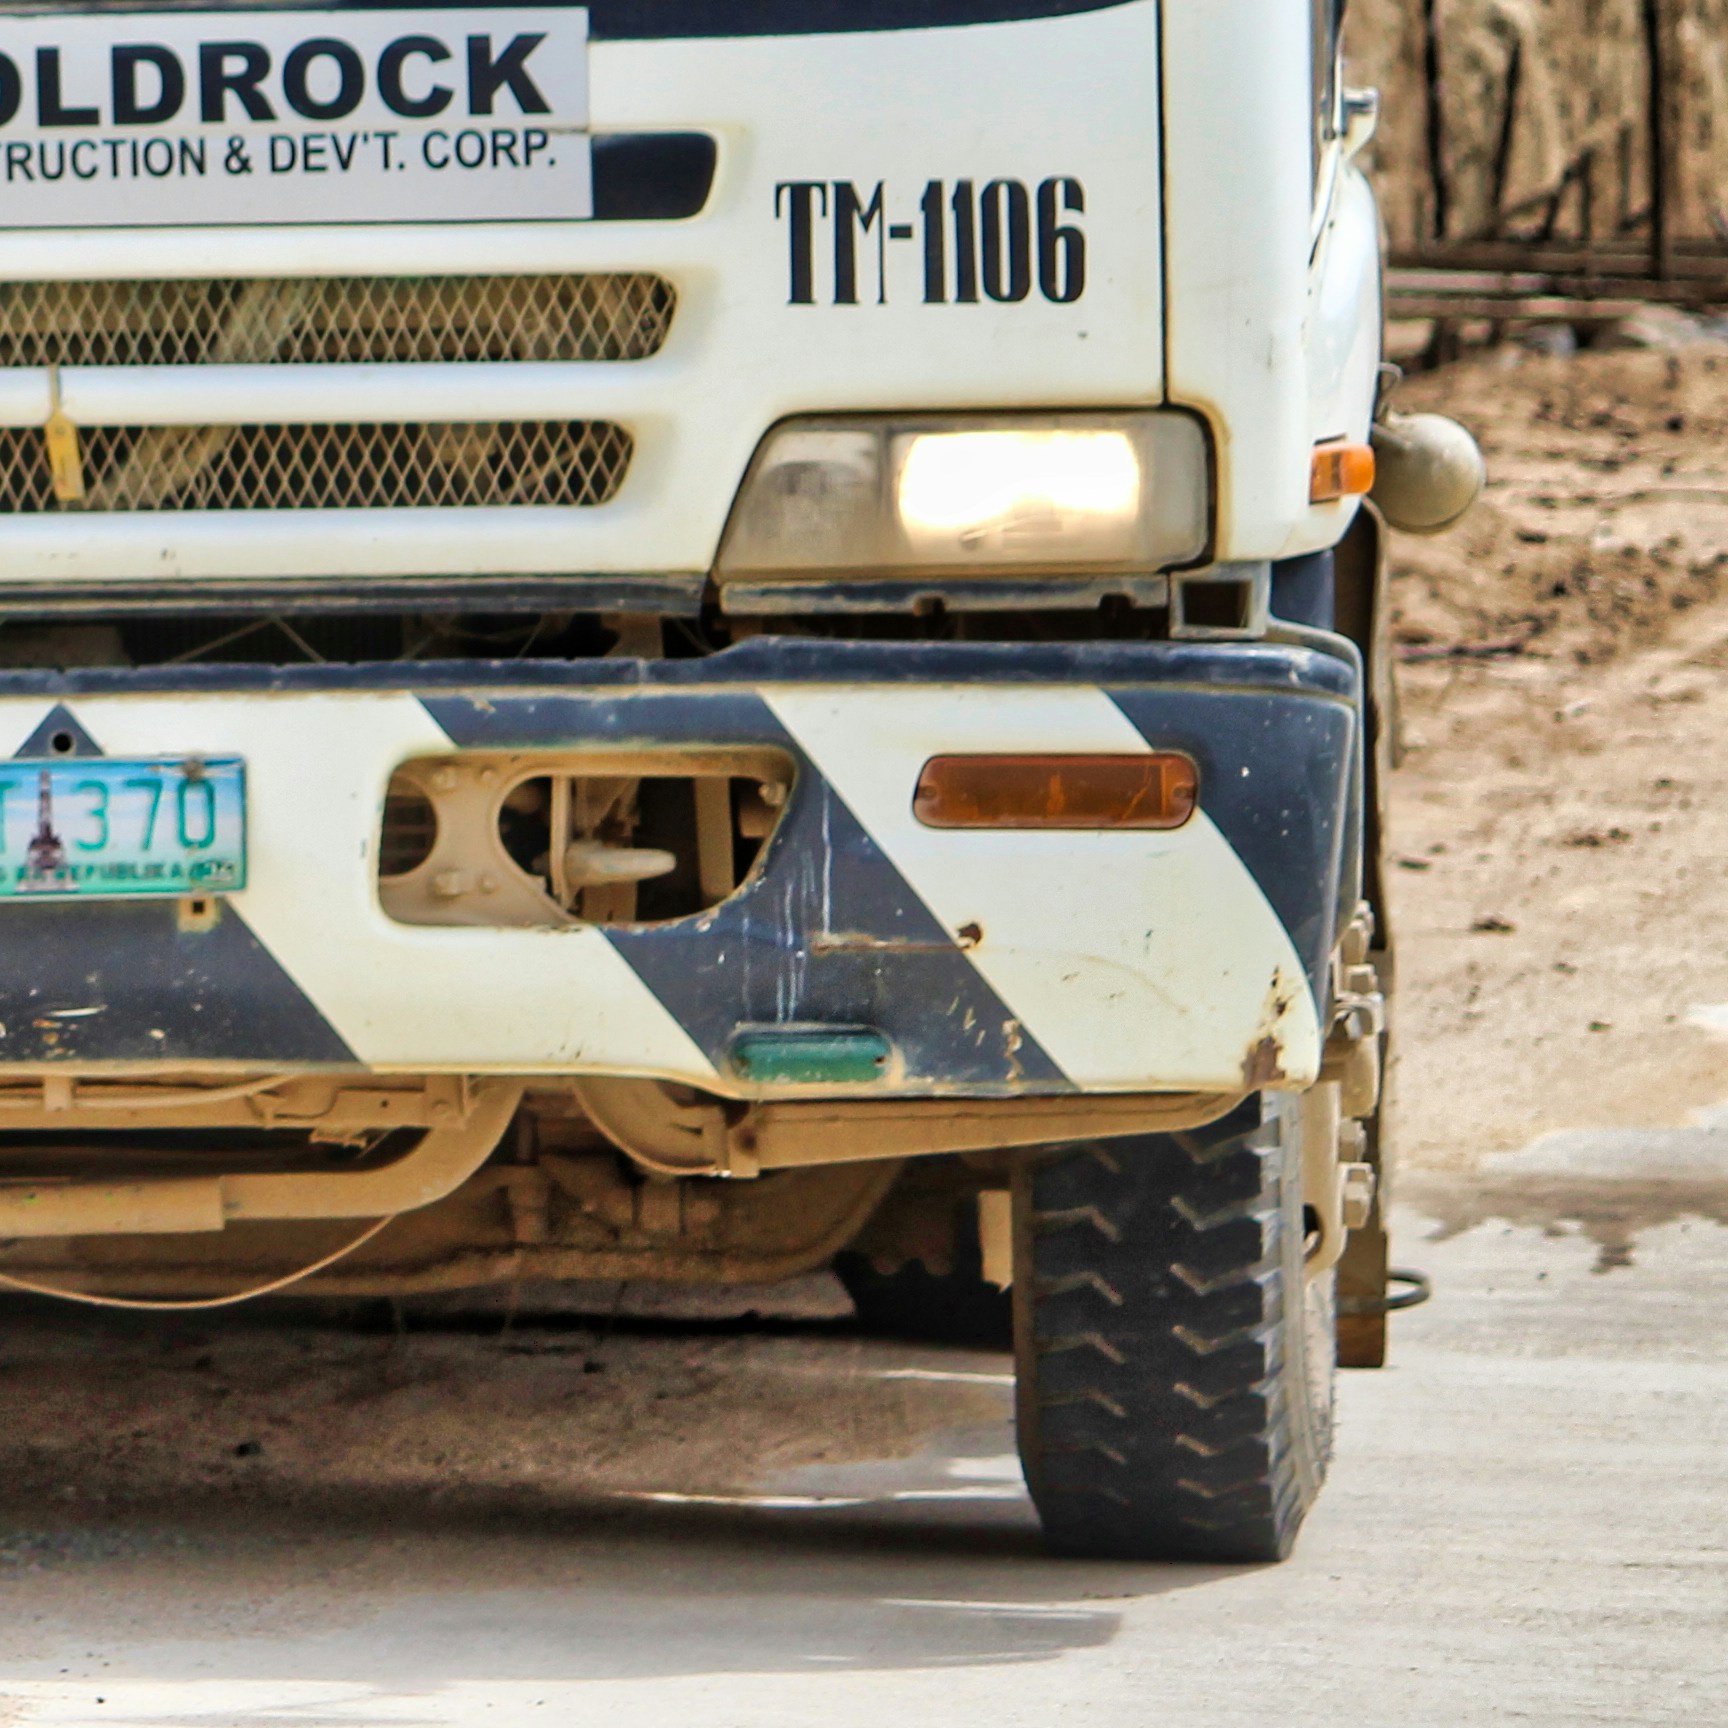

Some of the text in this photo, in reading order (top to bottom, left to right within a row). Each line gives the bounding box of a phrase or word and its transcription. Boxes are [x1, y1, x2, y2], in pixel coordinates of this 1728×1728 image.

[223, 131, 253, 176] &
[269, 132, 407, 176] DEV'T.
[422, 131, 557, 170] CORP.
[775, 176, 1086, 304] TM-1106
[72, 778, 216, 851] 370
